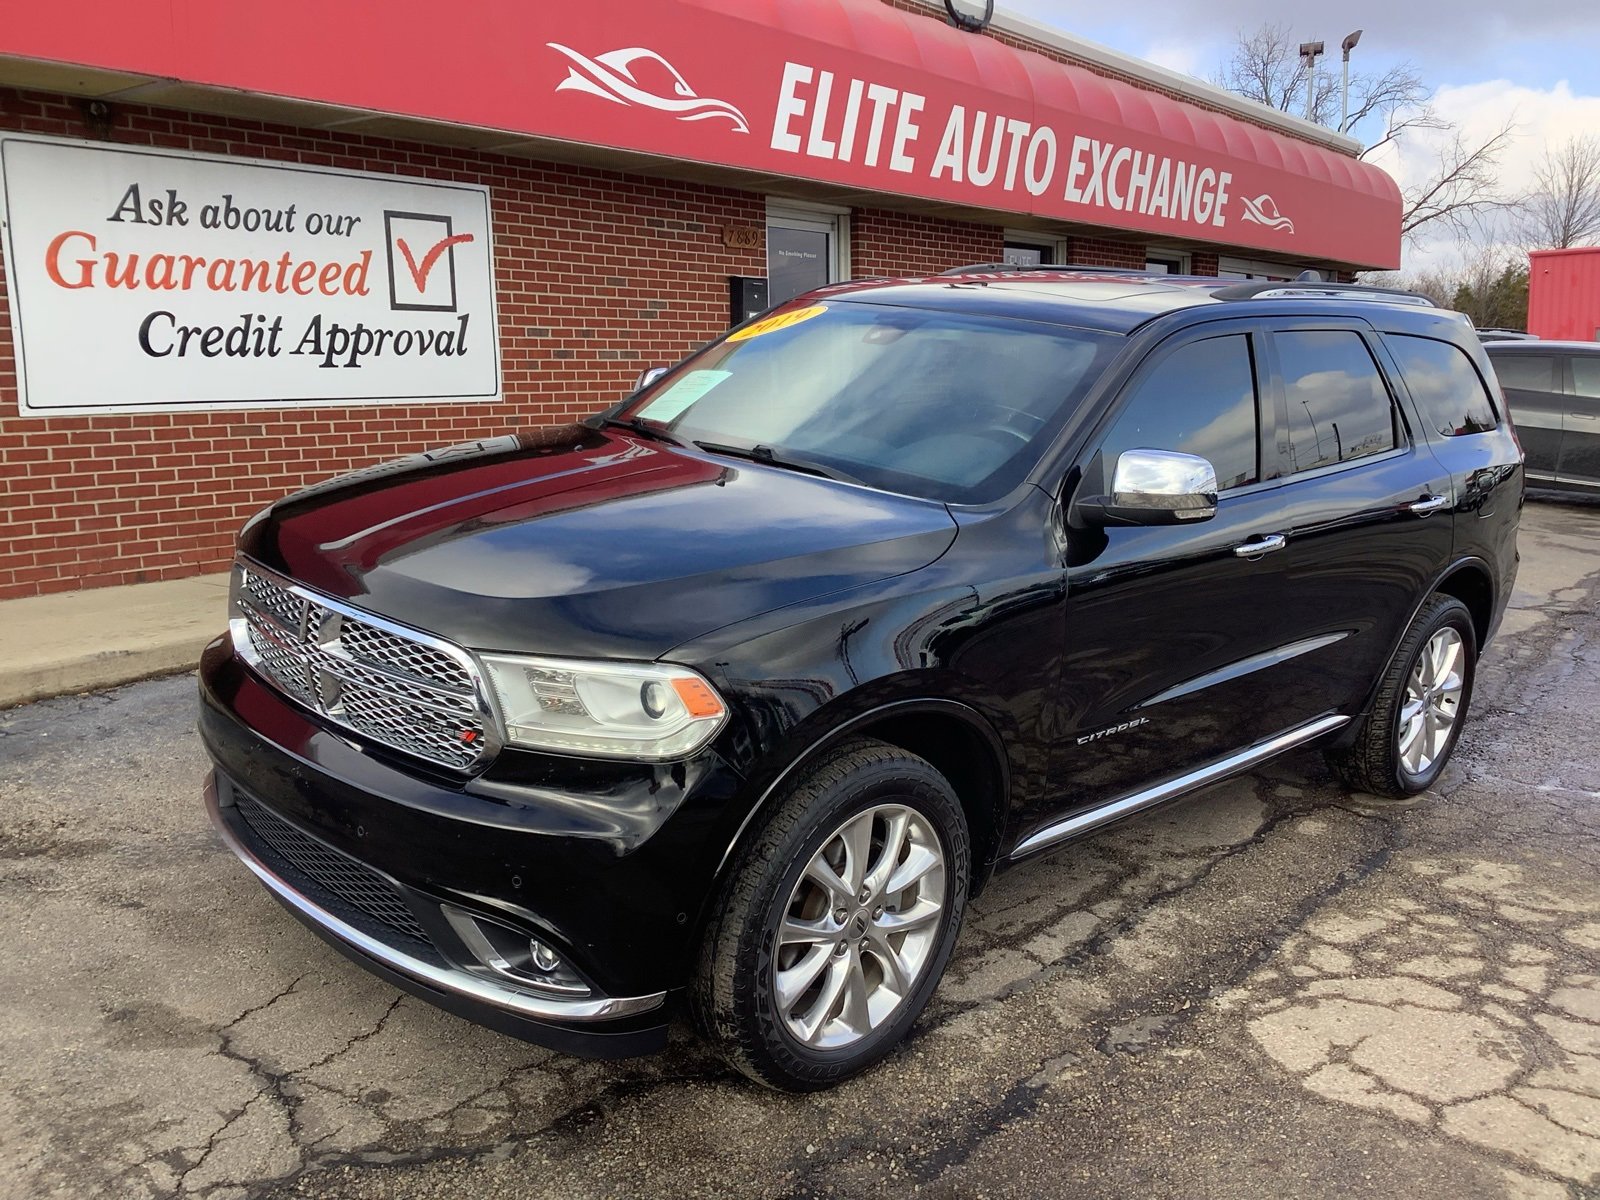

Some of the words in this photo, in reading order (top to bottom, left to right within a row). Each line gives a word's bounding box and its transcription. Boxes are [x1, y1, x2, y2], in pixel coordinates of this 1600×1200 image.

[770, 61, 926, 173] ELITE
[930, 104, 1057, 196] AUTO
[1064, 135, 1233, 228] EXCHANGE
[106, 183, 190, 227] Ask
[199, 194, 296, 234] about
[305, 212, 362, 237] our
[44, 230, 373, 297] Guaranteed
[728, 230, 758, 247] 7889
[138, 310, 283, 358] Credit
[289, 313, 470, 368] Approval
[404, 714, 464, 739] DODGE
[1076, 717, 1150, 745] CITADEL
